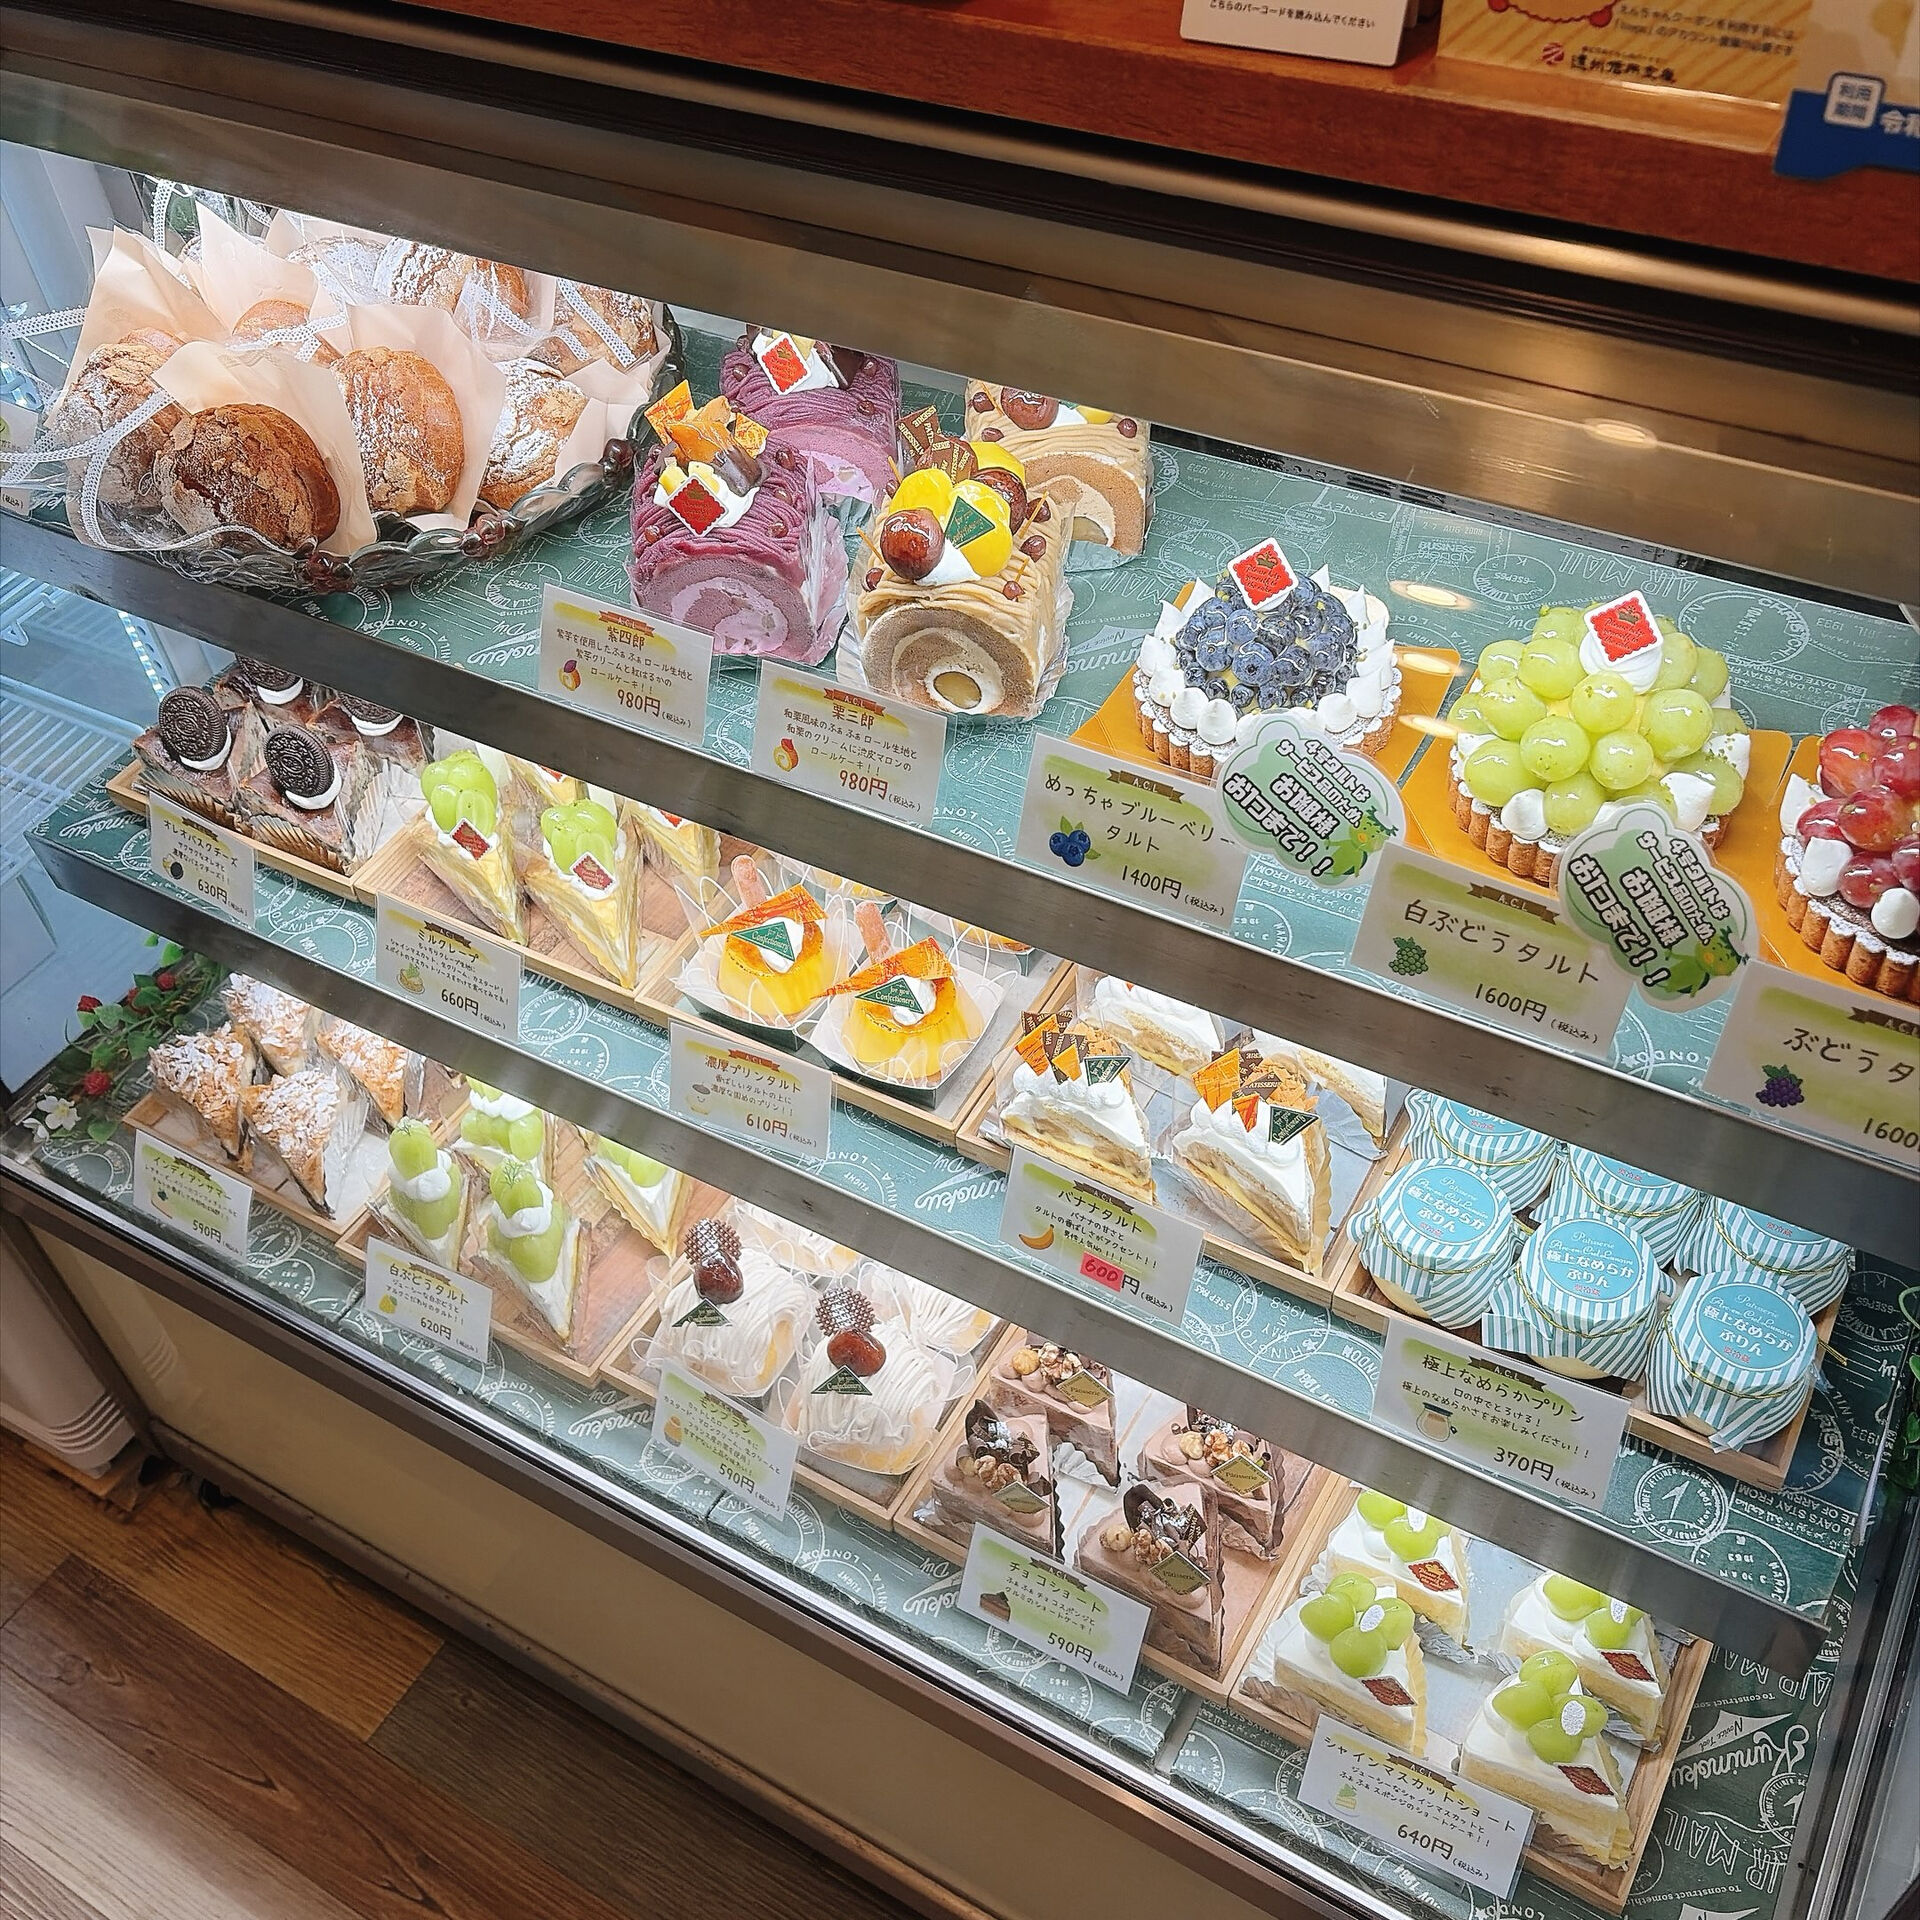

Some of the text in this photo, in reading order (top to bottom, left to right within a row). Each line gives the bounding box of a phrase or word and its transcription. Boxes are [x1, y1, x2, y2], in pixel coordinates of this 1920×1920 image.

[1557, 546, 1635, 589] MAIL
[606, 625, 646, 651] 紫四郎
[617, 689, 661, 718] 980円
[831, 703, 875, 731] 栗三郎
[839, 769, 921, 812] 980円 (税込み)
[1131, 778, 1159, 793] A.C.L
[1304, 738, 1371, 804] 4号タルトは
[1044, 773, 1236, 846] めっちゃブルーベリー
[1106, 825, 1160, 853] タルト
[197, 879, 228, 905] 630円
[1120, 865, 1225, 916] 1400円 (税込み)
[1254, 864, 1290, 881] FROM
[1669, 837, 1731, 921] 4号タルトは
[1497, 893, 1528, 912] A.C.L
[418, 929, 480, 963] ミルクレープ
[1403, 899, 1600, 985] 白ぶどうタルト
[441, 988, 479, 1017] 660円
[1474, 983, 1599, 1044] 1600円 (税込み)
[704, 1055, 801, 1094] 濃厚プリンタルト
[1783, 1027, 1918, 1084] ぶどうタ
[715, 1074, 793, 1106] 香ばしいタルトの上に
[745, 1113, 788, 1138] 610円
[1863, 1117, 1920, 1150] 1600
[1057, 1189, 1143, 1234] バナナタルト
[1070, 1211, 1125, 1242] バナナの甘さと
[1407, 1185, 1486, 1231] 極上なめらか
[192, 1219, 222, 1244] 590円
[1546, 1249, 1635, 1279] 極上なめらか
[389, 1263, 469, 1306] 白ぶどうタルト
[1084, 1258, 1174, 1312] 600 円 (税込み)
[420, 1317, 452, 1341] 620円
[1703, 1304, 1794, 1352] 極上なめらか
[1421, 1353, 1585, 1424] 極上なめらかプリン
[1493, 1365, 1521, 1382] A.C.L
[699, 1397, 752, 1434] モンブラン
[1453, 1387, 1542, 1427] 口の中でとろける！
[719, 1463, 755, 1494] 590円
[1492, 1446, 1597, 1500] 370円 (税込み)
[1008, 1561, 1102, 1614] チョコショート
[1047, 1632, 1093, 1664] 590円
[1670, 1722, 1810, 1791] Kumimoku
[1323, 1736, 1516, 1833] シャインマスカットショート
[1351, 1765, 1485, 1835] ジューシーなシャインマスカットと
[1397, 1823, 1490, 1881] 640円 (税込み)
[1662, 1806, 1740, 1876] MAIL
[1625, 1884, 1742, 1907] To construct somethin
